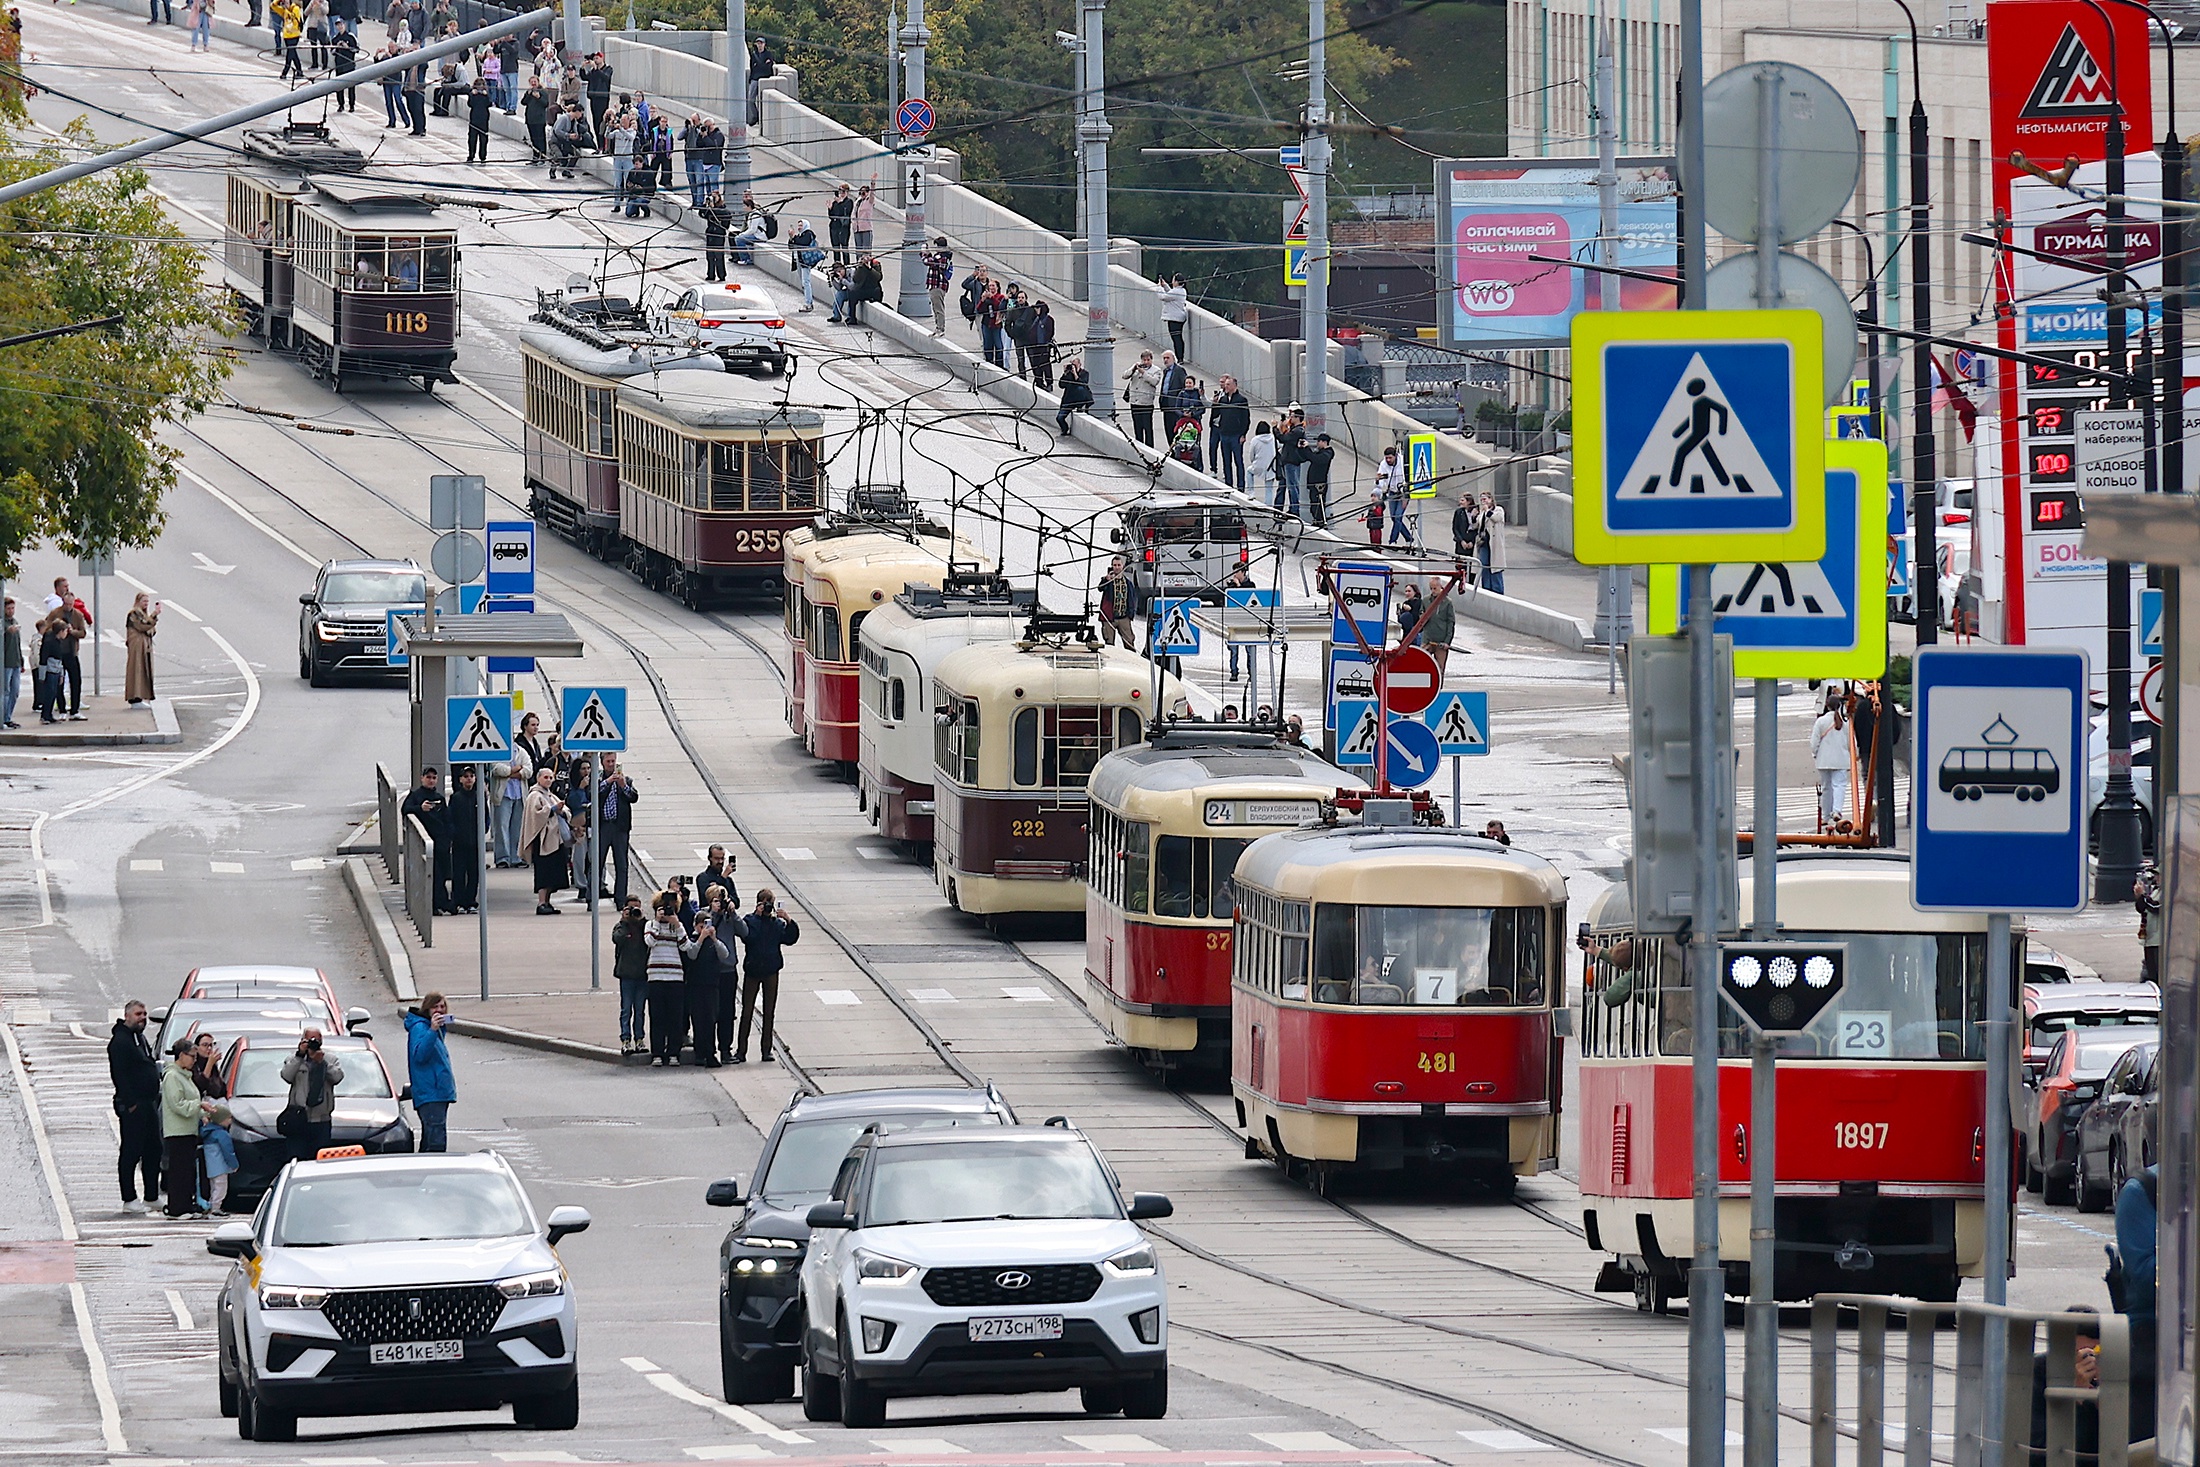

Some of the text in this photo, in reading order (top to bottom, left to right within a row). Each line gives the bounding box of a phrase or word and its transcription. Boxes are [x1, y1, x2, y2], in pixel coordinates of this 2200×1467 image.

[2016, 121, 2131, 134] НЕФТЬМАГИСТРЛЬ
[1466, 221, 1556, 237] оплачивай
[1466, 242, 1538, 254] частями
[1623, 232, 1666, 249] 399
[386, 312, 428, 333] 1113
[2035, 407, 2062, 428] 95
[2035, 454, 2070, 475] 100
[2085, 460, 2146, 473] САДОВОЕ
[2086, 476, 2138, 488] КОЛЬЦО
[2037, 501, 2064, 523] ДТ
[1209, 803, 1231, 820] 24
[1012, 820, 1045, 837] 222
[1206, 933, 1231, 951] 37
[1428, 976, 1444, 999] 7
[1845, 1020, 1885, 1048] 23
[1417, 1052, 1455, 1073] 481
[1834, 1122, 1889, 1149] 1897
[974, 1317, 1059, 1335] У273СН 198
[375, 1341, 460, 1361] Е481КЕ 550
